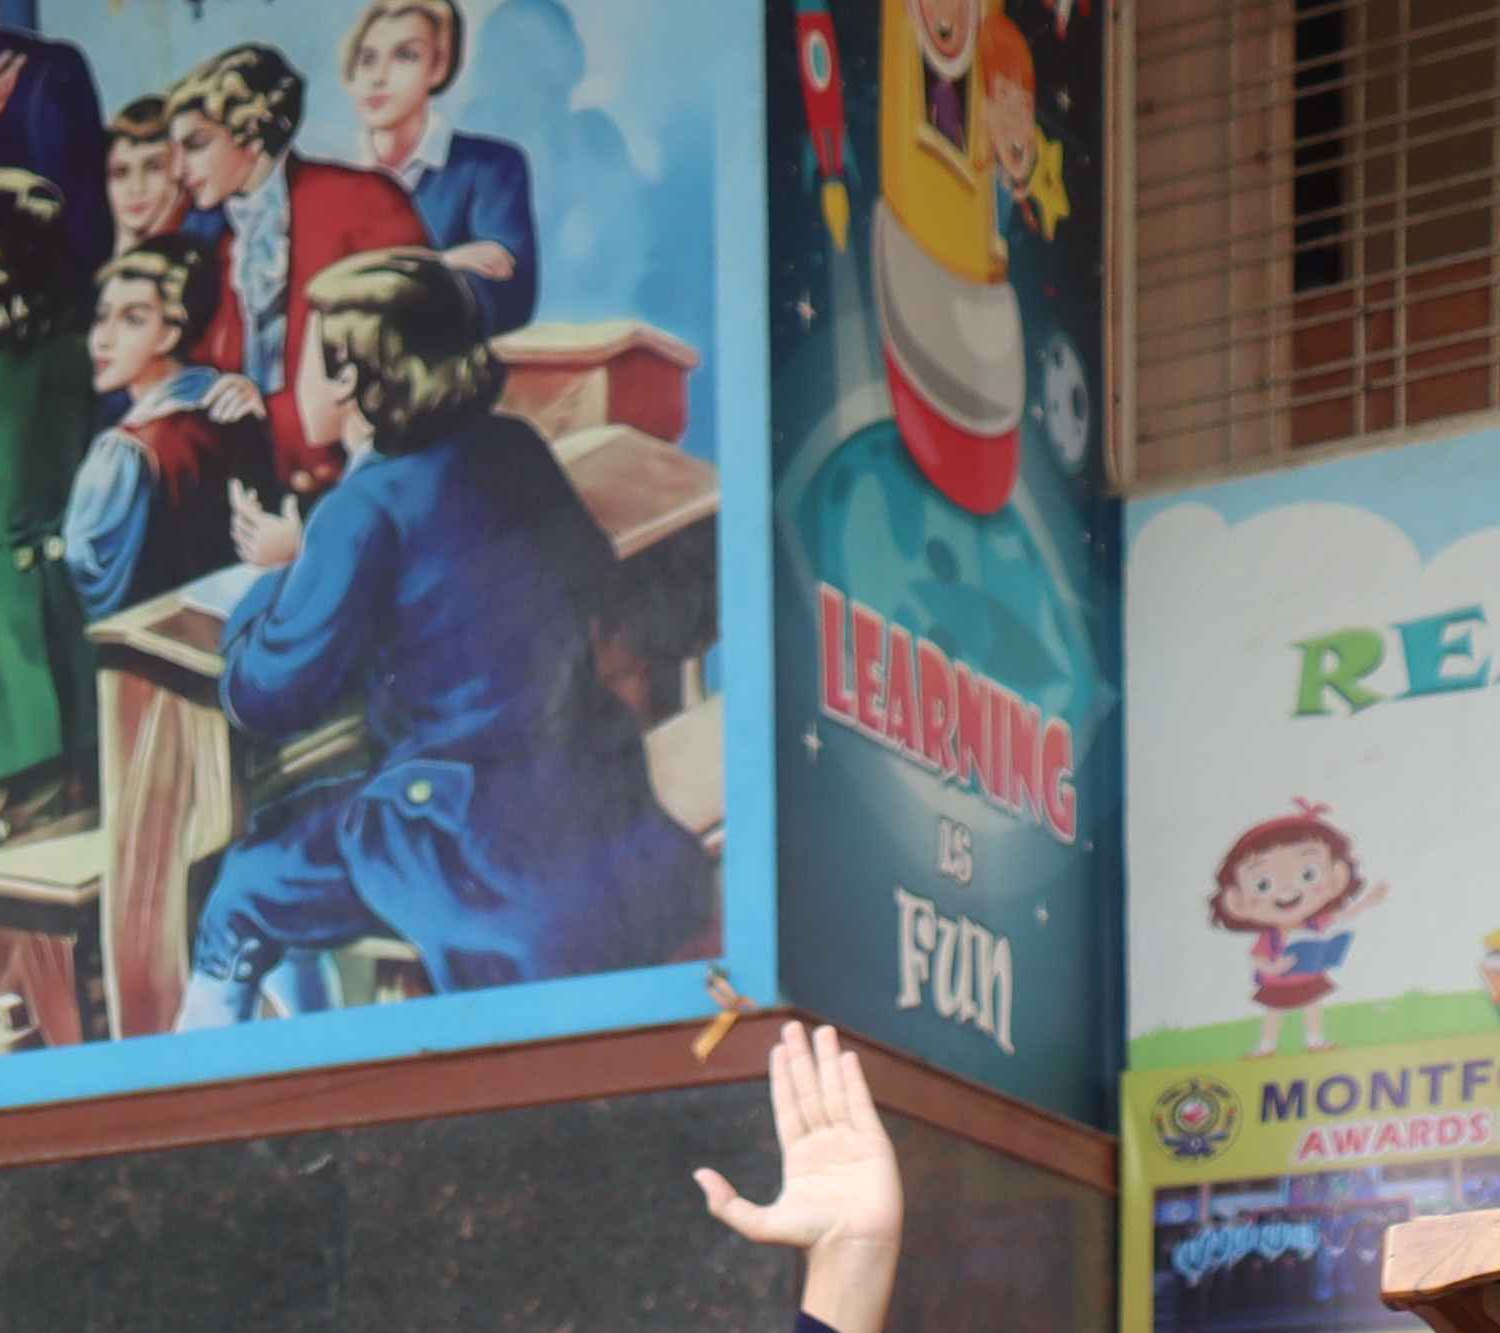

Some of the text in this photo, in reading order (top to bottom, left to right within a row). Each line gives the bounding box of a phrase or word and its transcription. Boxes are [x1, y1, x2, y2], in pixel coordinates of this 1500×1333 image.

[1290, 603, 1500, 719] RE
[820, 582, 1076, 847] LEARNING
[938, 816, 974, 886] IS
[1261, 1058, 1500, 1123] MONTF
[1298, 1111, 1490, 1162] AWARDS
